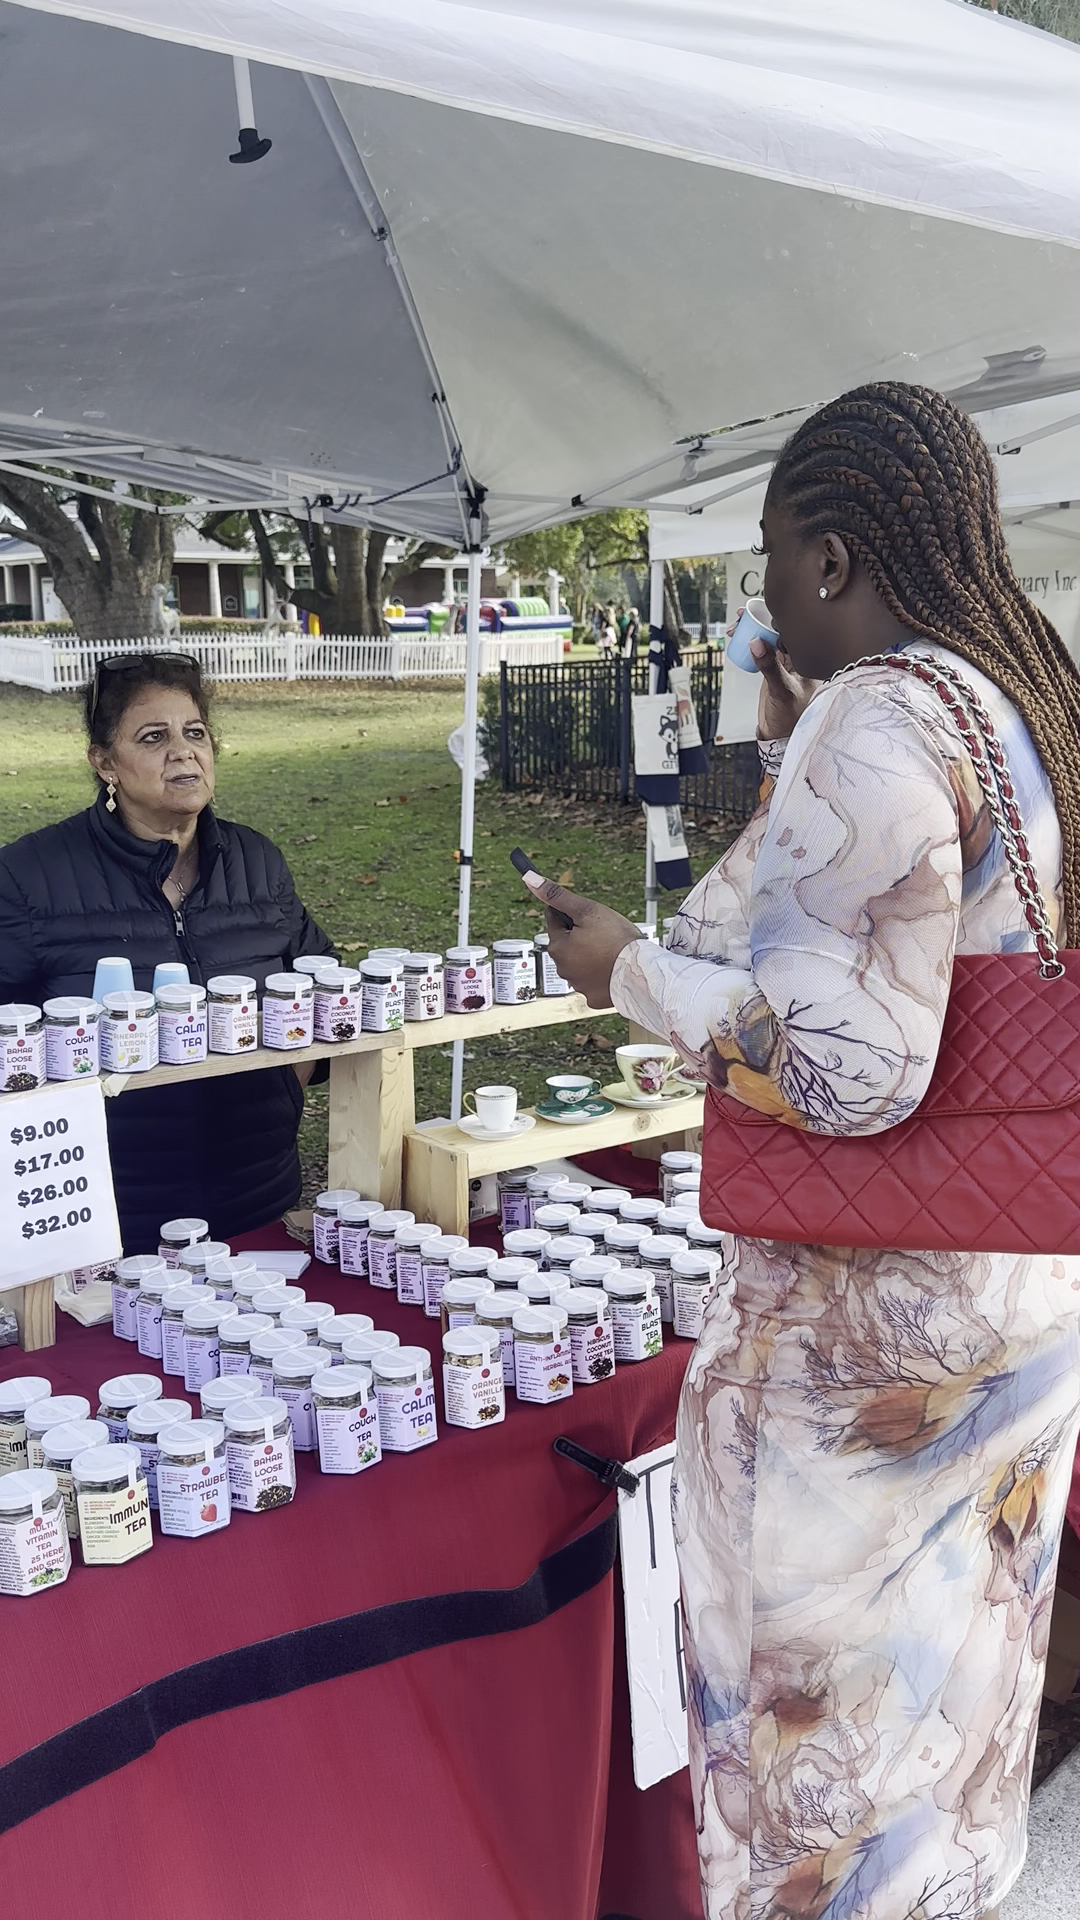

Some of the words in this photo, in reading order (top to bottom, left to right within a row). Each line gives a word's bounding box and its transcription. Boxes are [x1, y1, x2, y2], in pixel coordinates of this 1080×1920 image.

[386, 990, 402, 998] MINT
[421, 994, 439, 1004] TEA
[385, 999, 405, 1008] BLAST
[330, 1010, 356, 1018] COCONUT
[175, 1023, 206, 1036] CALM
[65, 1036, 95, 1046] COUGH
[119, 1039, 147, 1048] LEMON
[182, 1037, 202, 1048] TEA
[7, 1047, 33, 1055] BAHAR
[72, 1048, 89, 1057] TEA
[6, 1055, 33, 1063] LOOSE
[10, 1117, 69, 1146] $9.00
[13, 1145, 85, 1177] $17.00
[17, 1176, 89, 1209] $26.00
[21, 1207, 92, 1240] $32.00
[90, 1265, 109, 1275] LOOSE
[642, 1307, 659, 1320] MINT
[641, 1318, 661, 1332] BLAST
[587, 1334, 611, 1347] HIBISCUS
[645, 1329, 659, 1341] TEA
[586, 1341, 612, 1354] COCONUT
[585, 1351, 604, 1361] LOOSE
[471, 1377, 503, 1391] ORANGE
[401, 1393, 435, 1414] CALM
[482, 1396, 497, 1405] TEA
[348, 1413, 377, 1433] COUGH
[410, 1412, 433, 1429] TEA
[356, 1430, 372, 1443] TEA
[253, 1452, 283, 1467] BAHAR
[254, 1463, 283, 1478] LOOSE
[261, 1475, 278, 1486] TEA
[200, 1488, 219, 1502] TEA
[29, 1521, 53, 1535] MULTI
[125, 1516, 147, 1535] TEA
[25, 1529, 58, 1546] VITAMIN
[36, 1541, 52, 1552] TEA
[31, 1556, 41, 1564] 25
[27, 1564, 45, 1575] AND
